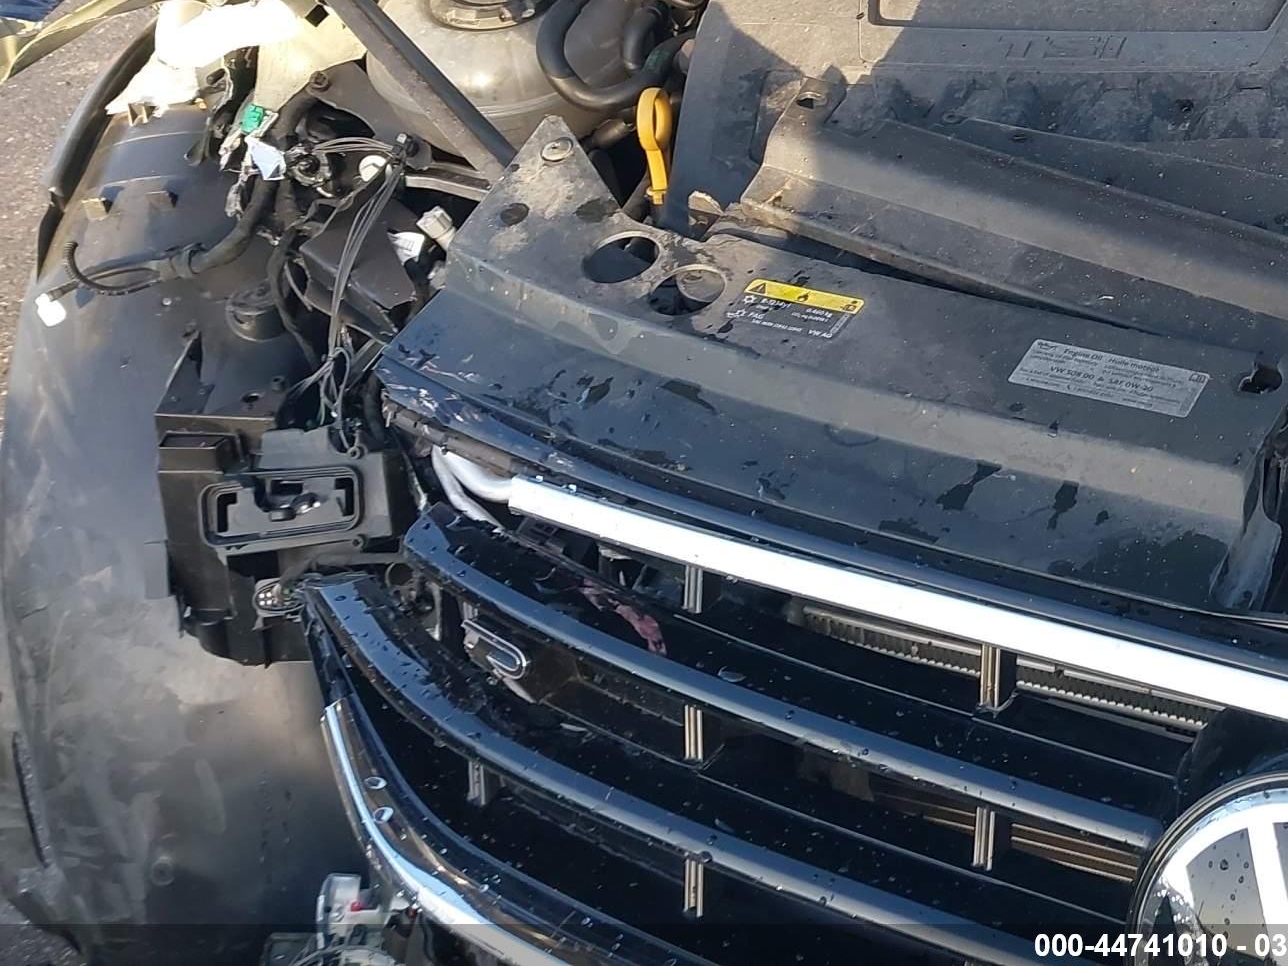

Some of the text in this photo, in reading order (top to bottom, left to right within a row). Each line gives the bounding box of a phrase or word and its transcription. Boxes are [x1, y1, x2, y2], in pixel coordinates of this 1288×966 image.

[1063, 348, 1091, 359] Engine
[1091, 353, 1104, 362] Oil
[1050, 365, 1067, 374] VW
